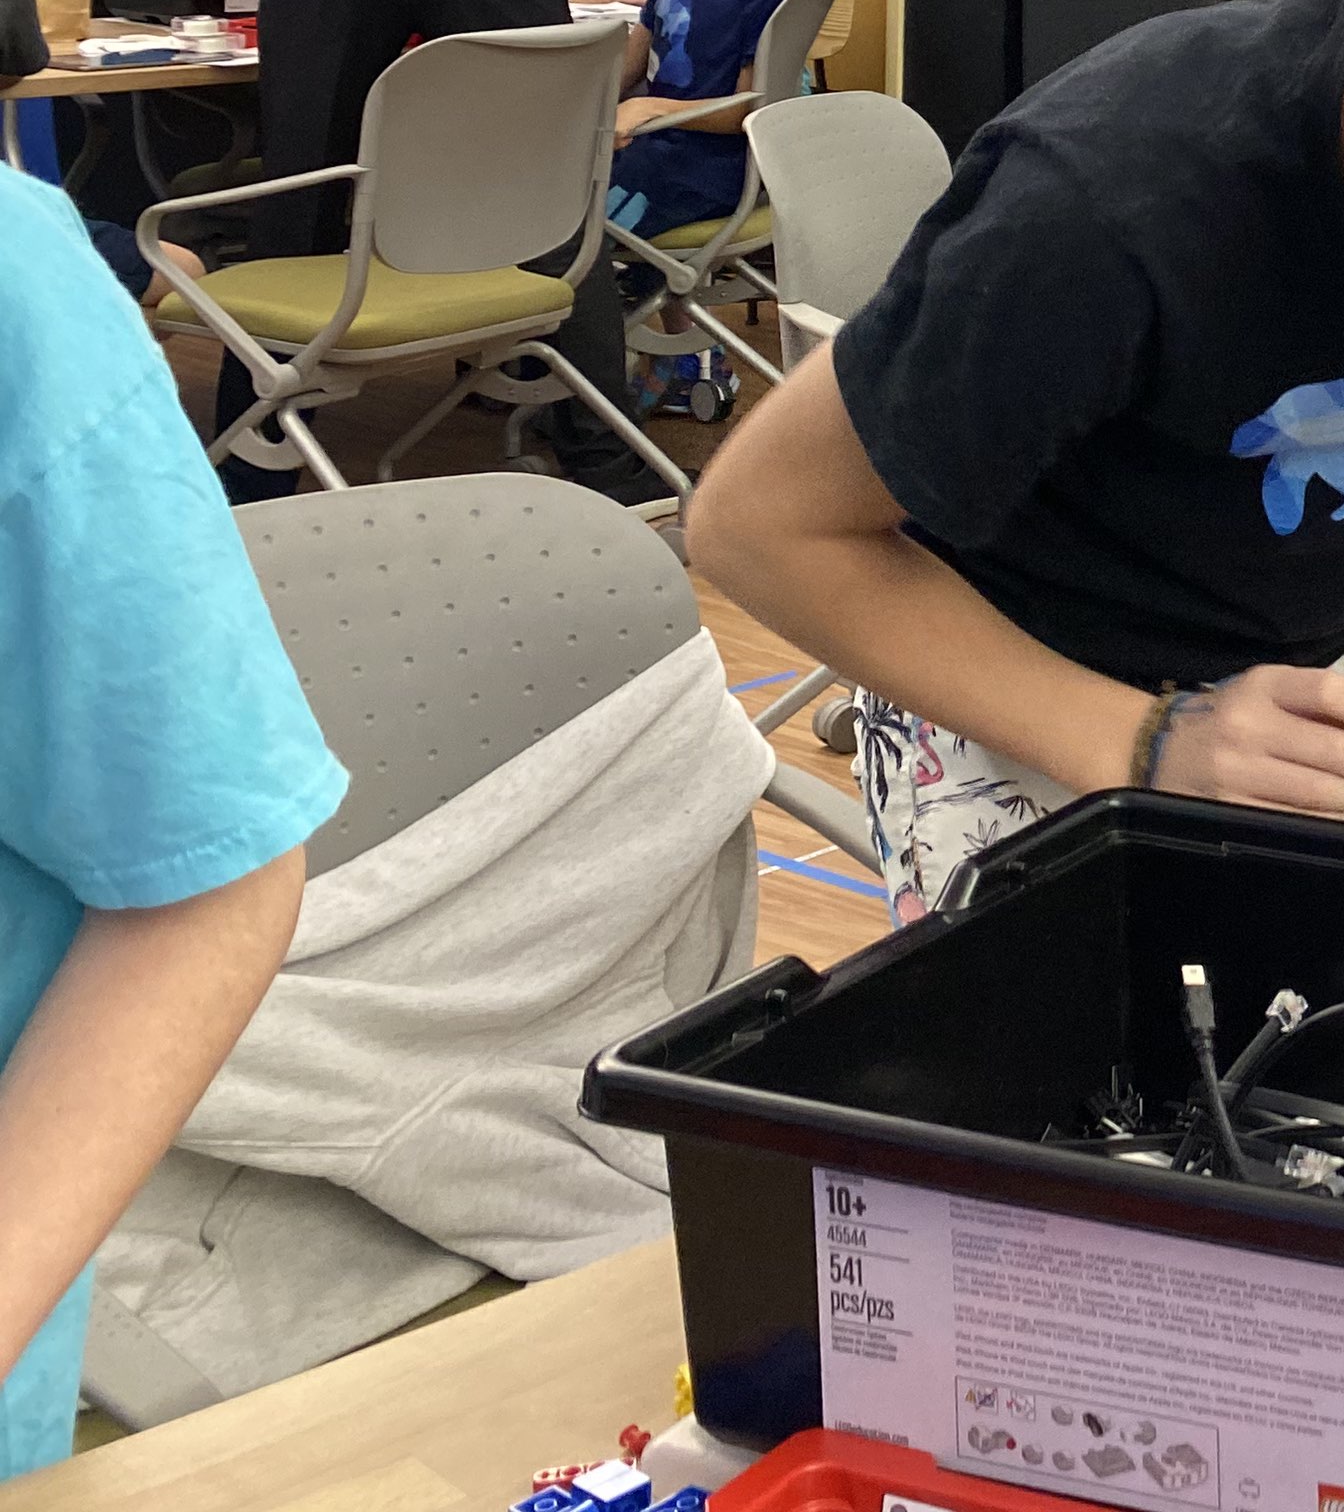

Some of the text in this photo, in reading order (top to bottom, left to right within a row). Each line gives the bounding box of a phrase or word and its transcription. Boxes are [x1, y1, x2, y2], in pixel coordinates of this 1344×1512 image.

[826, 1184, 867, 1217] 10+
[827, 1224, 867, 1248] 45544
[830, 1253, 863, 1287] 541
[831, 1290, 895, 1324] pcs/pzs
